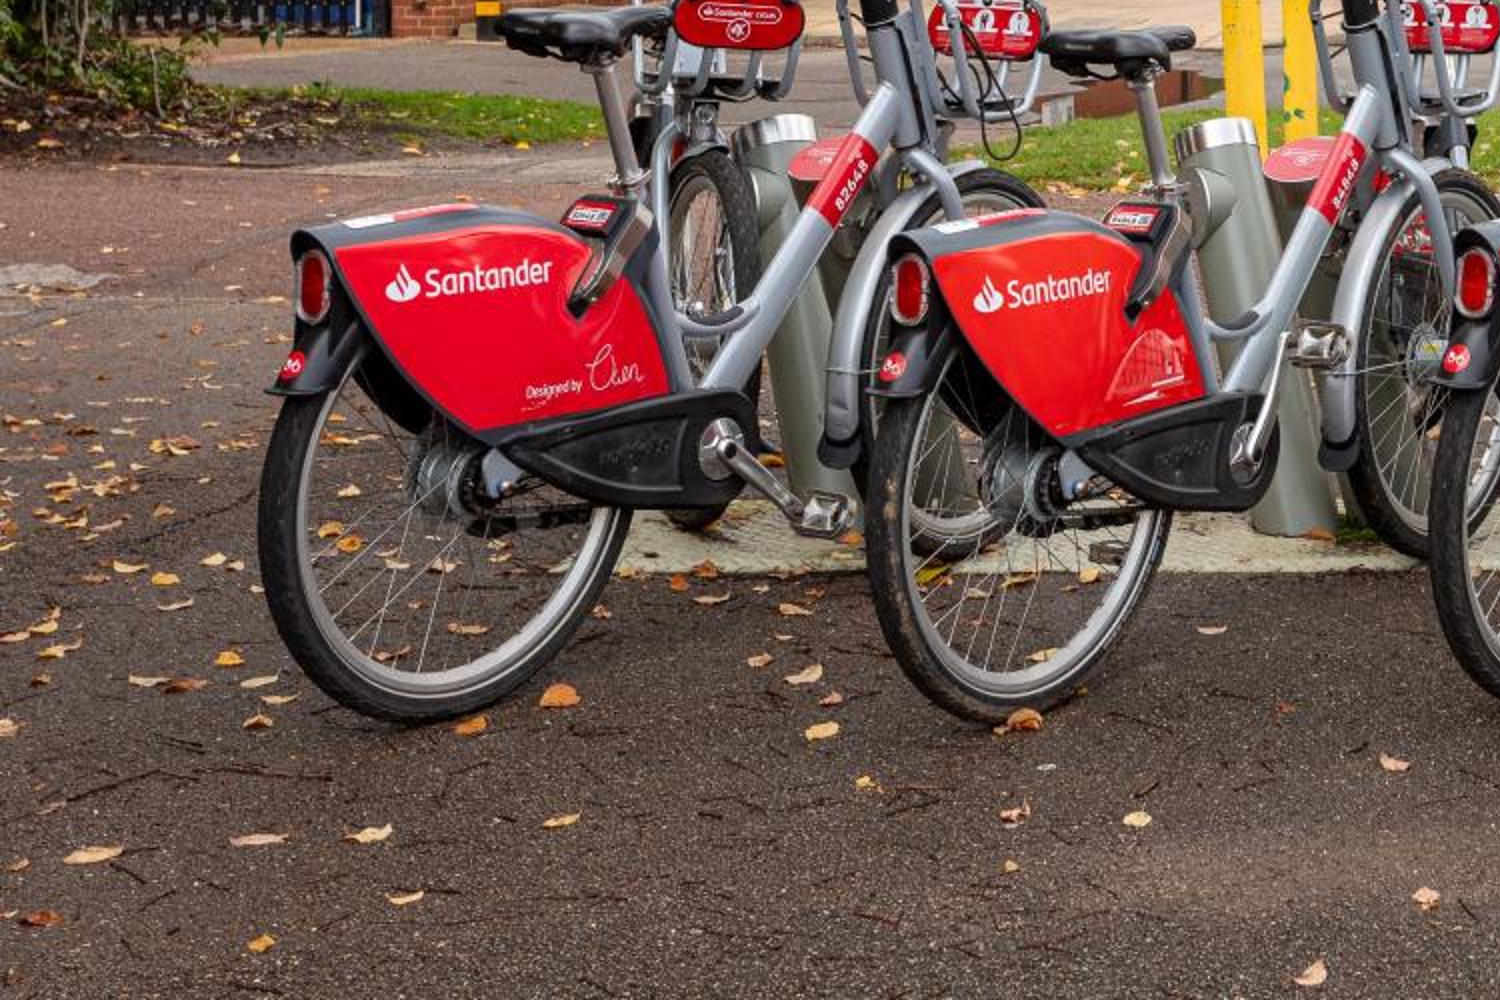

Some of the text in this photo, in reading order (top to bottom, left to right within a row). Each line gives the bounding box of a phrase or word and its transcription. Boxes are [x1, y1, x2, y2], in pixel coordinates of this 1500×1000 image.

[834, 159, 869, 211] 82648
[425, 258, 554, 298] Santander
[1007, 268, 1113, 309] Santander
[525, 380, 569, 400] Designed
[571, 379, 583, 396] by
